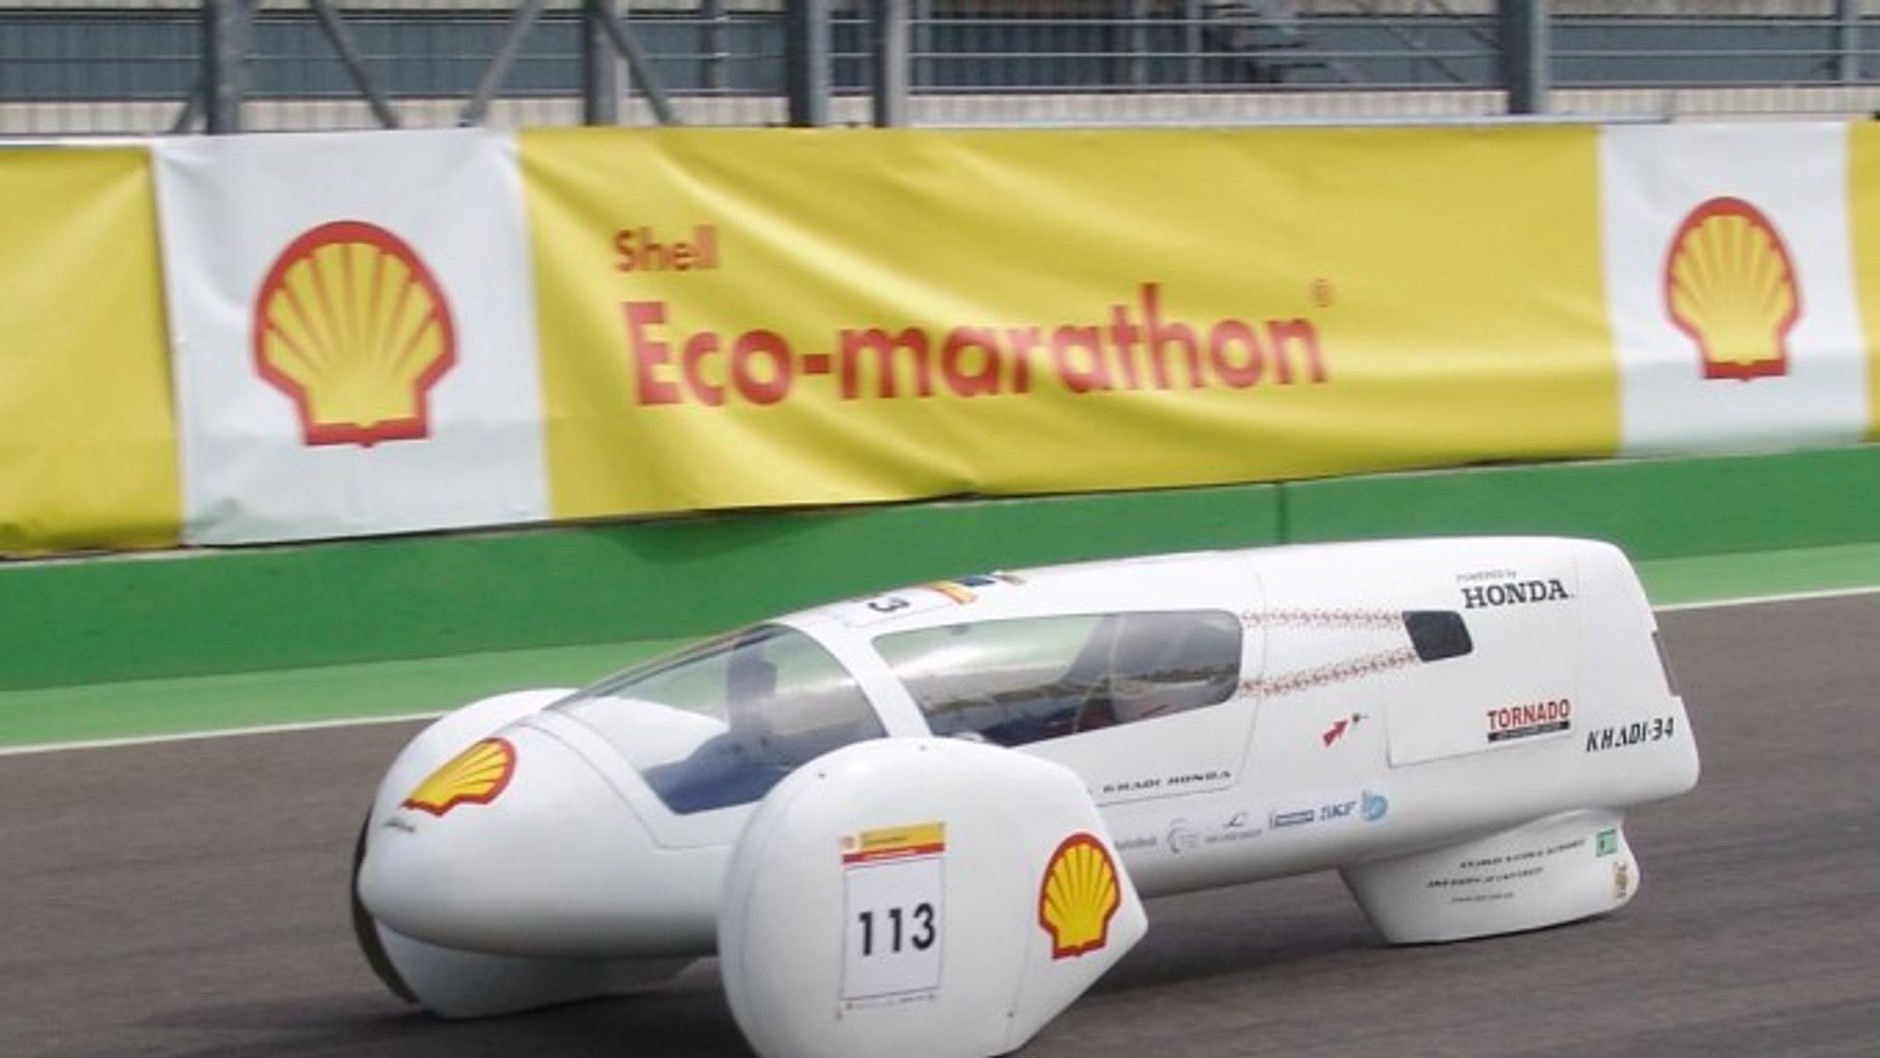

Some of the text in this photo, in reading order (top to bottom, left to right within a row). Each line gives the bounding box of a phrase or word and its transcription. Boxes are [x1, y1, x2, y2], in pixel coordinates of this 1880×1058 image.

[613, 224, 720, 272] Shell
[620, 281, 1328, 407] Eco-marathon
[1461, 578, 1570, 609] HONDA
[1486, 698, 1571, 731] TORNADO
[858, 902, 936, 957] 113
